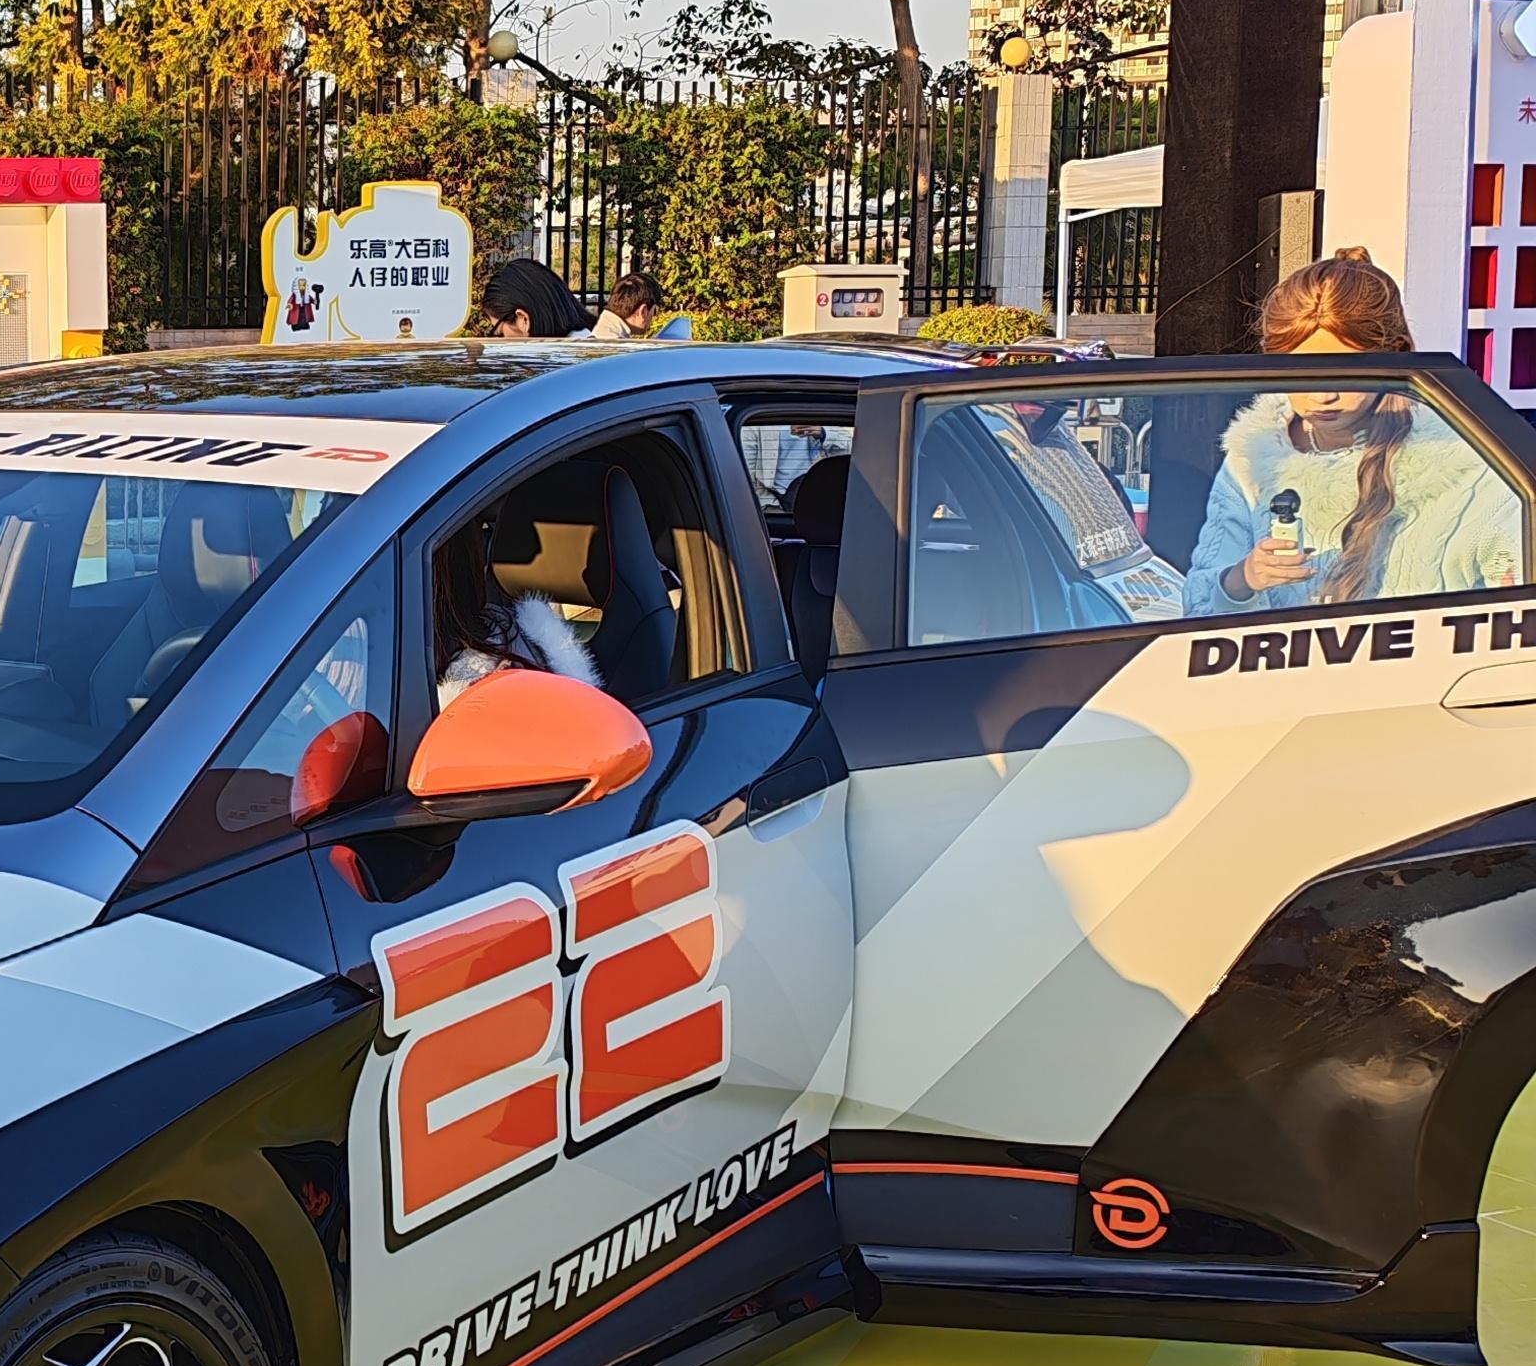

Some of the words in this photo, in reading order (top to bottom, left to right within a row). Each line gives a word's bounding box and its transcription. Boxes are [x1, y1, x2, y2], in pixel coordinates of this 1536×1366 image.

[348, 265, 450, 288] 人仔的职业
[1111, 568, 1174, 612] LOVE
[1188, 619, 1415, 678] DRIVE
[374, 822, 730, 1230] 22
[553, 1191, 688, 1313] THINK
[693, 1124, 795, 1226] LOVE
